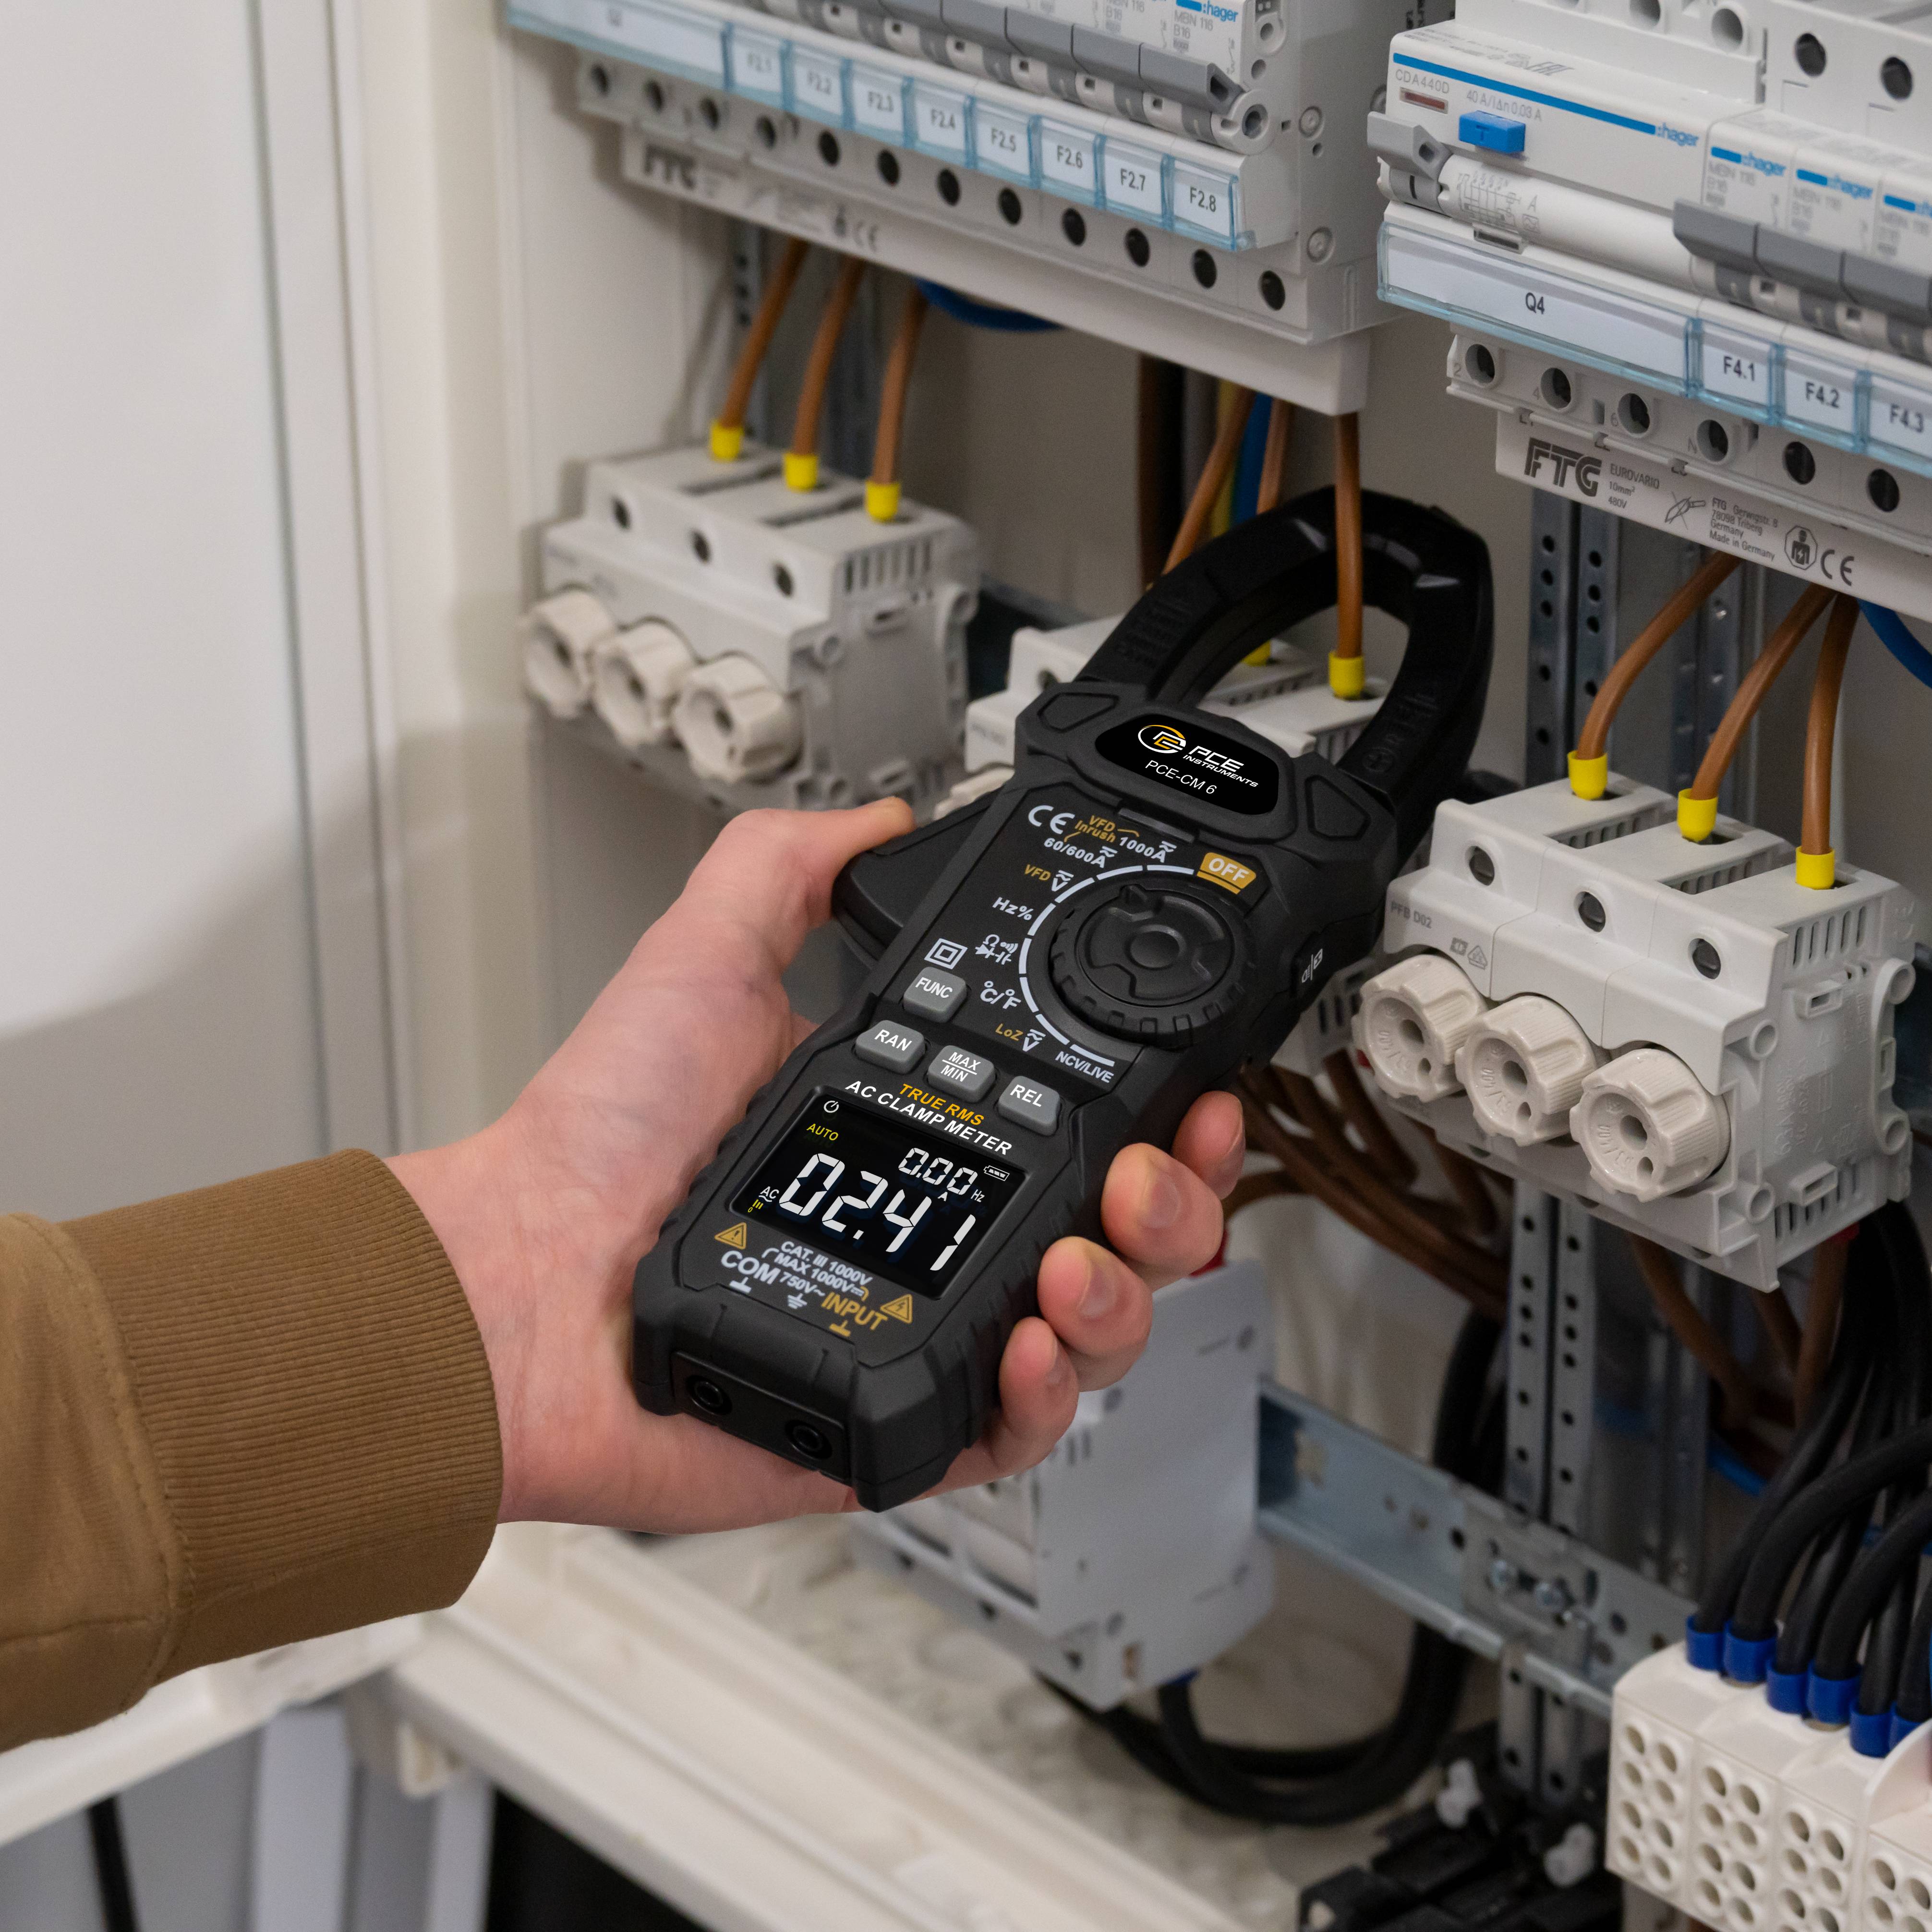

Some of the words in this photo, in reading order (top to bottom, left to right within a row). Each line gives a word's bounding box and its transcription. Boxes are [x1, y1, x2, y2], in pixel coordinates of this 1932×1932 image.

[1173, 24, 1191, 39] B16
[1174, 10, 1196, 27] MBN
[1200, 14, 1213, 32] 116
[868, 90, 894, 113] F2.3
[930, 108, 956, 130] F2.4
[990, 127, 1017, 153] F2.5
[1057, 145, 1084, 169] F2.6
[1120, 168, 1147, 192] F2.7
[1189, 187, 1217, 213] F2.8
[1525, 292, 1545, 314] Q4
[1723, 356, 1756, 382] F4.1
[1805, 383, 1840, 409] F4.2
[1890, 404, 1924, 433] F4.3
[1524, 437, 1602, 497] FTG
[1610, 463, 1660, 489] EUROVARIO
[1608, 495, 1627, 509] 480V
[1712, 497, 1727, 510] FTG
[1710, 519, 1744, 538] Germany
[1712, 510, 1735, 524] 78098
[1737, 517, 1763, 536] Triberg
[1709, 530, 1730, 545] Made
[1732, 536, 1739, 547] in
[1742, 540, 1775, 562] Germany
[1820, 549, 1855, 587] CE
[1183, 754, 1259, 787] INSTRUMENTS
[1188, 746, 1244, 772] PCE
[1145, 760, 1206, 790] PCE-CM
[1206, 785, 1218, 795] 6
[1028, 805, 1075, 834] CE
[1075, 820, 1117, 843] Inrush
[1088, 815, 1116, 832] VFD
[1024, 864, 1052, 881] VFD
[1208, 857, 1250, 882] OFF
[1413, 911, 1432, 929] D02
[915, 977, 953, 1000] FUNC
[874, 1029, 912, 1051] RAN
[995, 1023, 1024, 1041] LoZ
[940, 1065, 968, 1082] MIN
[948, 1051, 981, 1071] MAX
[1055, 1051, 1114, 1083] NCV/LIVE
[900, 1083, 947, 1110] TRUE
[944, 1104, 985, 1125] RMS
[1010, 1084, 1043, 1107] REL
[845, 1080, 877, 1098] AC
[877, 1092, 944, 1125] CLAMP
[944, 1120, 1012, 1156] METER
[807, 1123, 839, 1141] AUTO
[898, 1147, 978, 1195] 0.00
[970, 1190, 985, 1203] Hz
[760, 1186, 779, 1199] AC
[779, 1153, 976, 1271] 02.41
[937, 1191, 948, 1201] A
[721, 1250, 781, 1285] COM
[773, 1253, 811, 1275] MAX
[781, 1241, 813, 1261] CAT.
[813, 1254, 829, 1268] III
[830, 1261, 873, 1285] 1000V
[821, 1292, 888, 1331] INPUT
